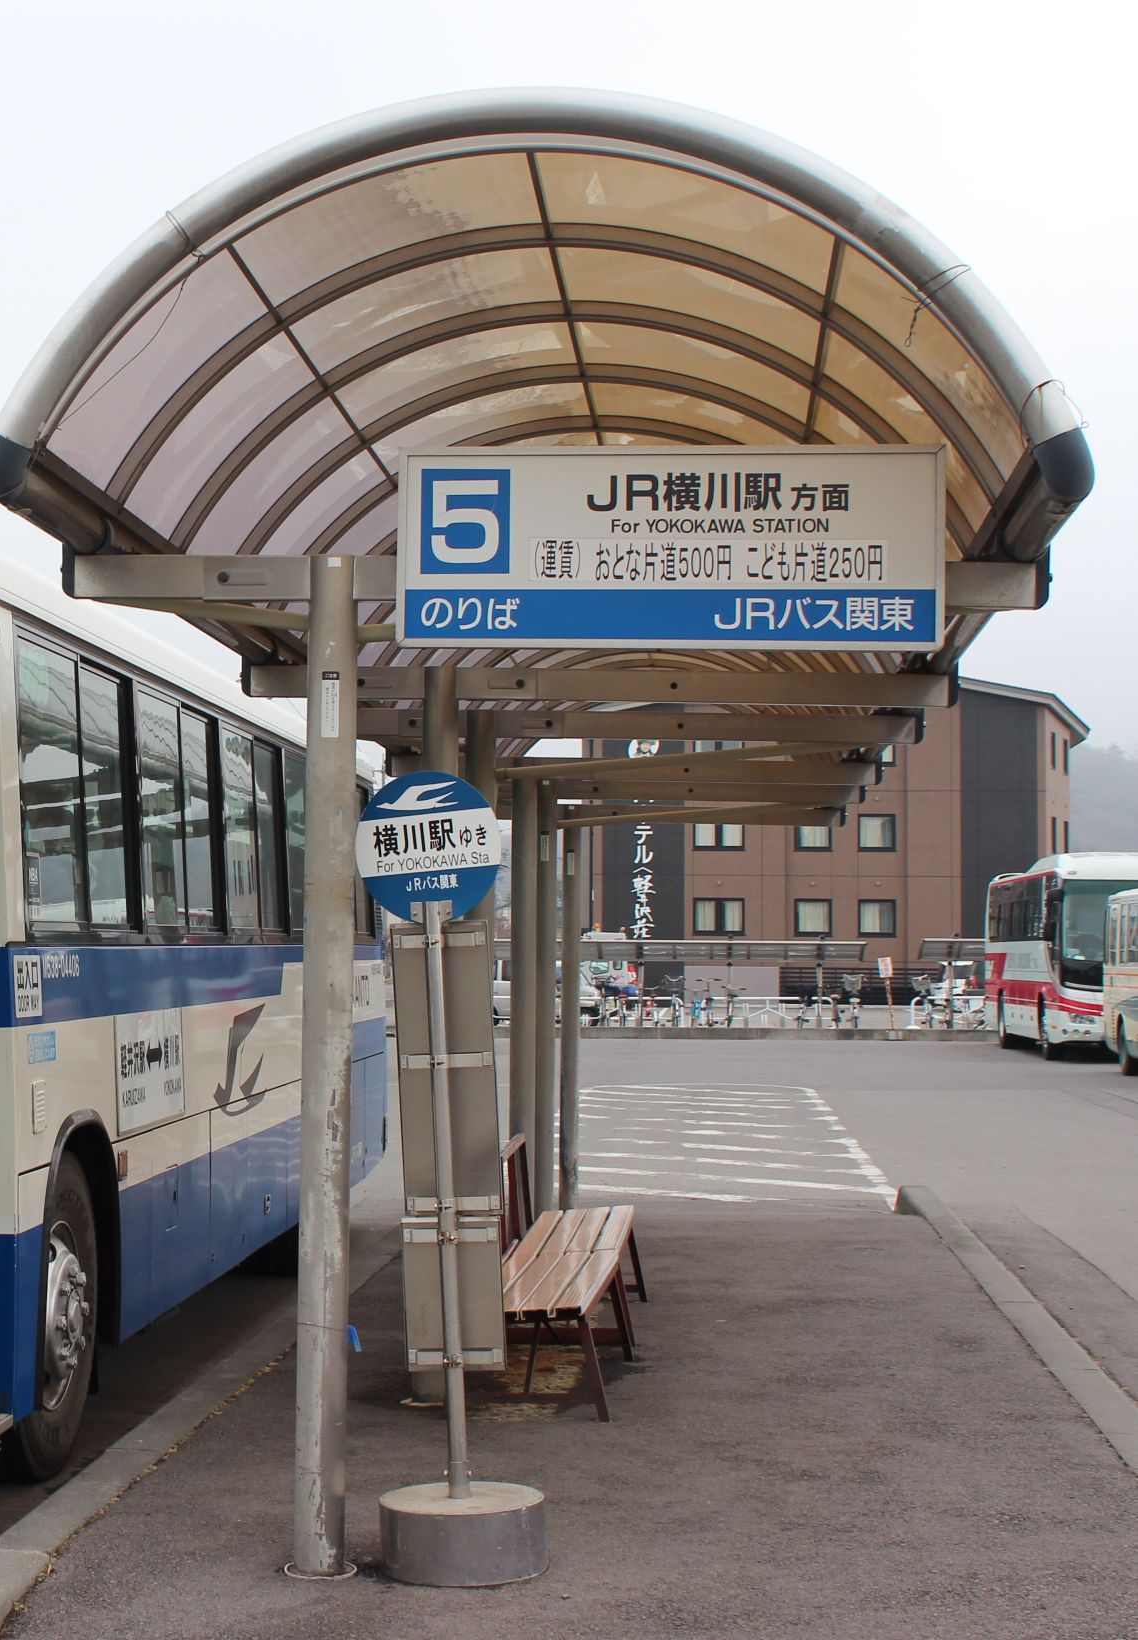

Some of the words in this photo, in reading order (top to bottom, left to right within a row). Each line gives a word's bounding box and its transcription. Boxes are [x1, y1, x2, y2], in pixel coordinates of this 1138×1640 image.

[430, 478, 500, 565] 5
[610, 518, 640, 534] For
[644, 518, 747, 534] YOKOKAWA
[752, 517, 830, 534] STATION
[420, 596, 520, 630] のりば
[713, 596, 915, 632] JRバス関東
[376, 860, 396, 874] For
[397, 853, 468, 872] YOKOKAWA
[471, 851, 490, 865] Sta
[405, 873, 459, 892] JRバス関東
[16, 960, 40, 991] 出入口
